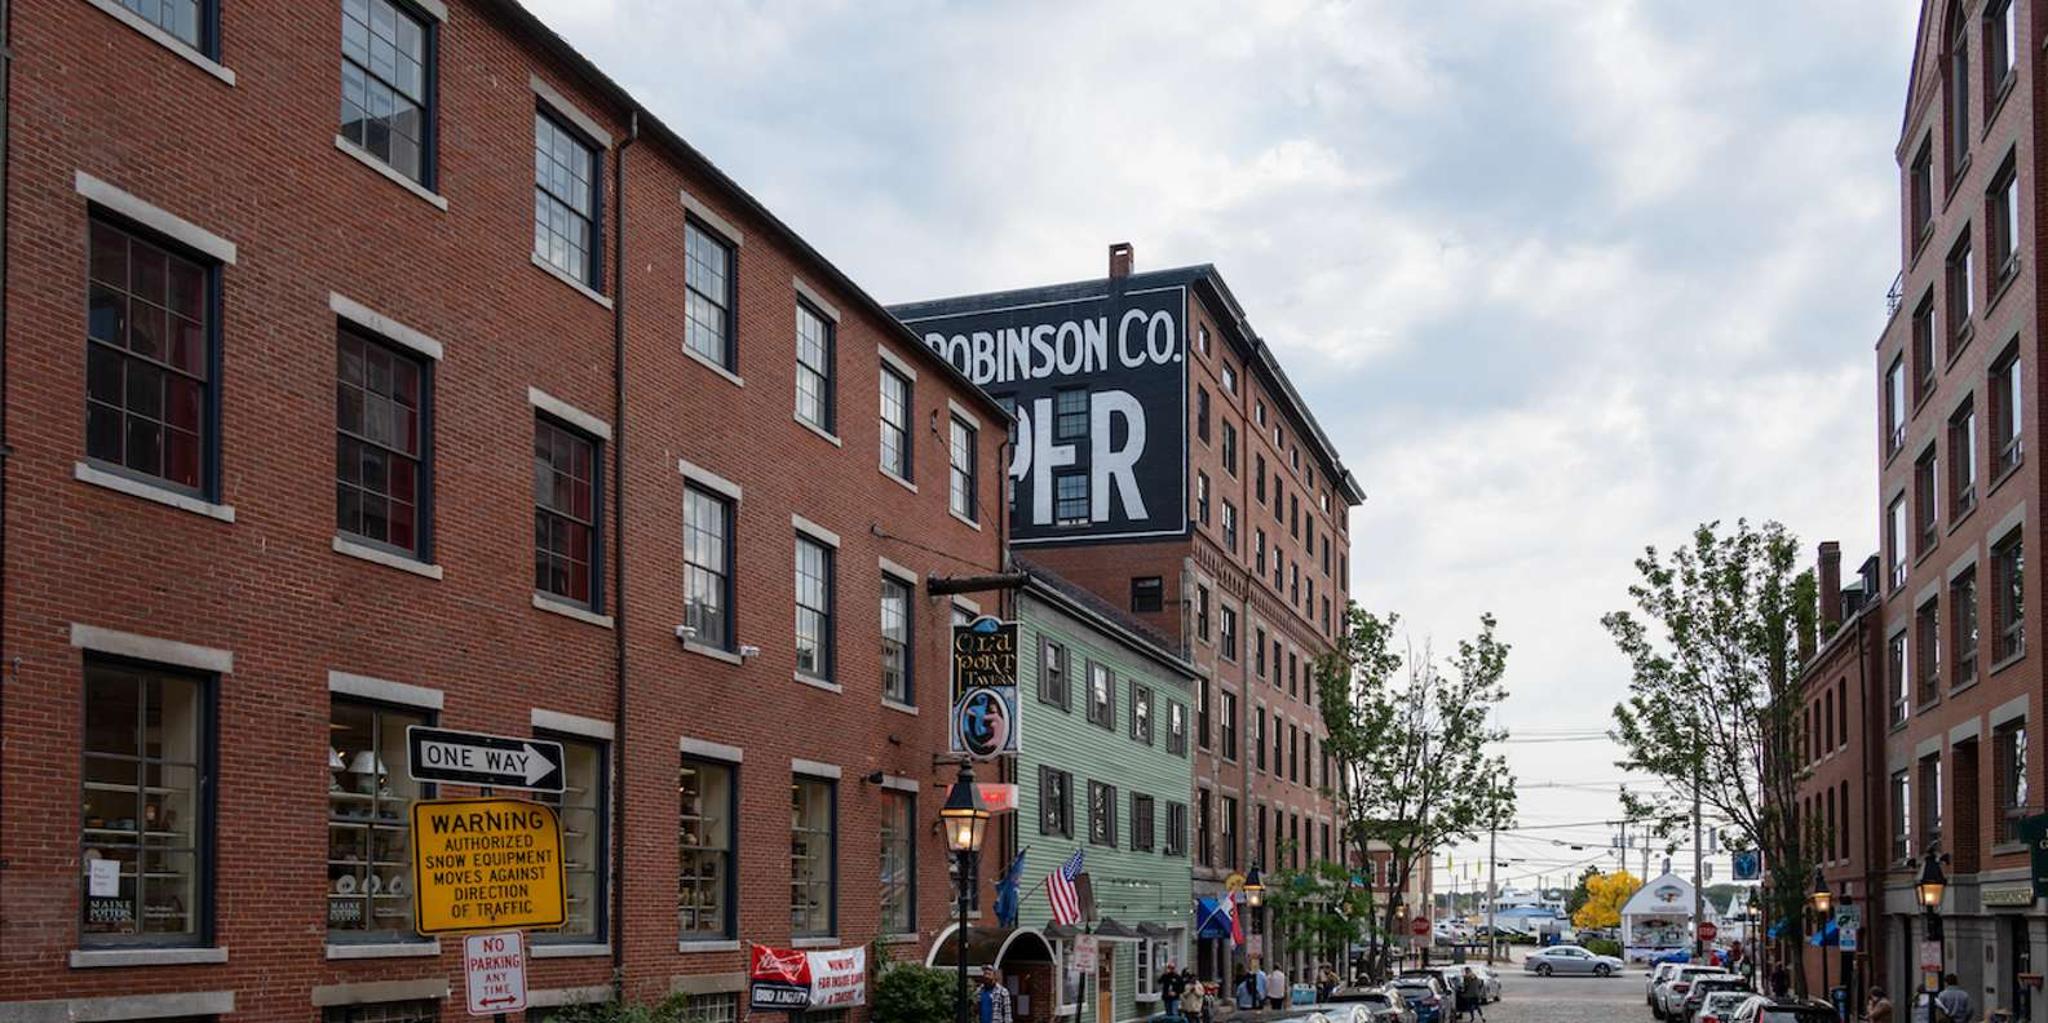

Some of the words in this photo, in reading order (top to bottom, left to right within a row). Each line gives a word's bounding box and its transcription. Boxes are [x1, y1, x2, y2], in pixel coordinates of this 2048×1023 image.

[1118, 308, 1182, 368] CO.
[428, 745, 474, 768] ONE
[485, 751, 529, 773] WAY
[445, 834, 534, 852] AUTHORIZED
[425, 855, 466, 870] SNOW
[473, 849, 553, 867] EQUIPMENT
[434, 869, 483, 886] MOVES
[489, 866, 546, 882] AGAINST
[454, 884, 529, 901] DIRECTION
[90, 900, 132, 909] MAINE
[451, 903, 470, 919] OF
[477, 900, 533, 917] TRAFFIC
[483, 938, 505, 953] NO
[471, 954, 520, 971] PARKING
[486, 972, 507, 982] ANY
[484, 984, 511, 994] TIME
[756, 988, 775, 1002] BUD
